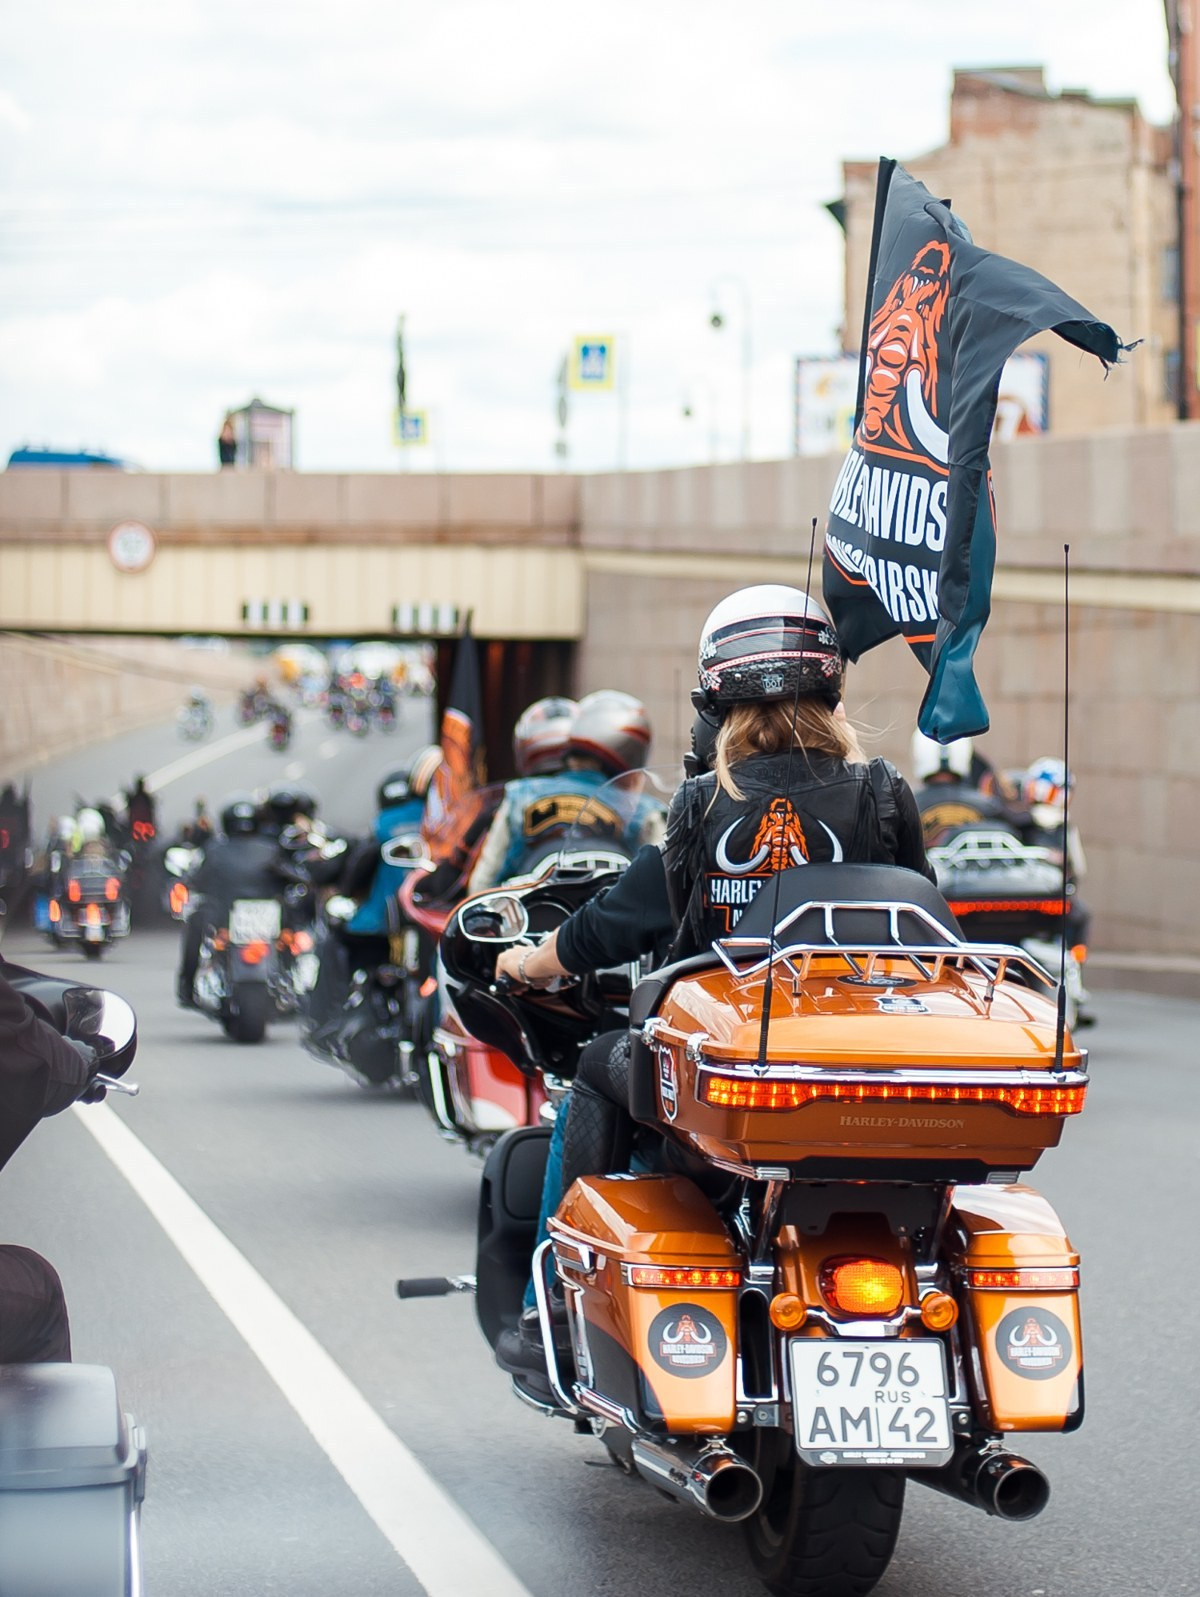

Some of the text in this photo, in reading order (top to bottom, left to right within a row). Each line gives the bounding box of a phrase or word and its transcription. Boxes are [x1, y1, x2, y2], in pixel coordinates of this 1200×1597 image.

[839, 1115, 966, 1129] HARLEY-DAVIDSON
[816, 1351, 920, 1388] 6796
[874, 1390, 912, 1403] RUS
[808, 1406, 938, 1443] AM 42
